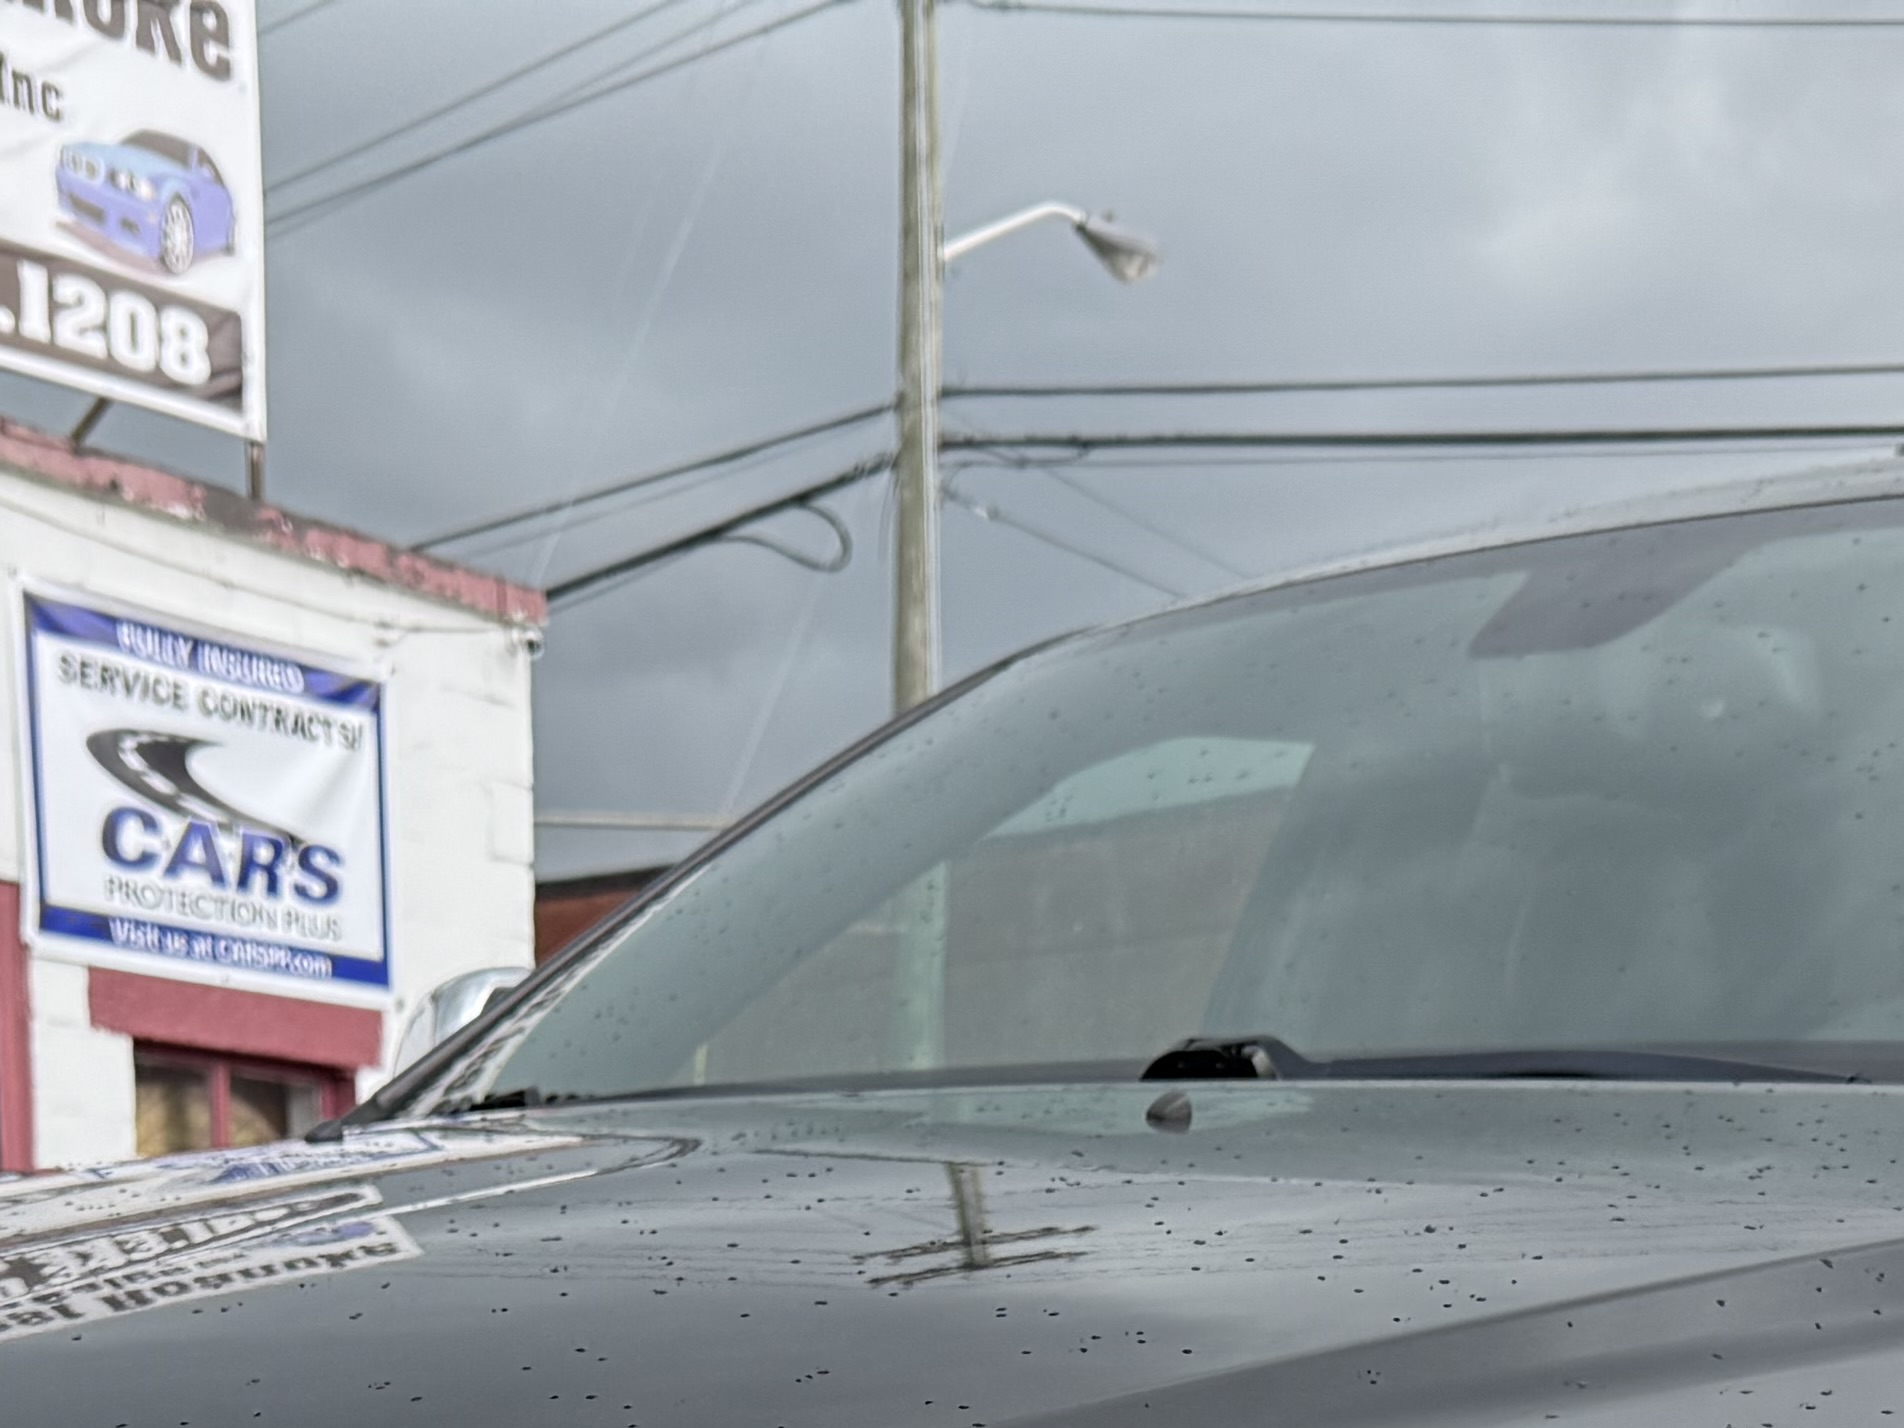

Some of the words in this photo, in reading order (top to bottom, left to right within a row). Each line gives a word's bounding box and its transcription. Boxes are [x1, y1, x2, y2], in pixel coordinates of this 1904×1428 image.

[58, 653, 188, 711] SERVICE
[101, 806, 346, 905] CARS
[105, 875, 279, 932] PROTECTION
[280, 904, 344, 941] PLUS
